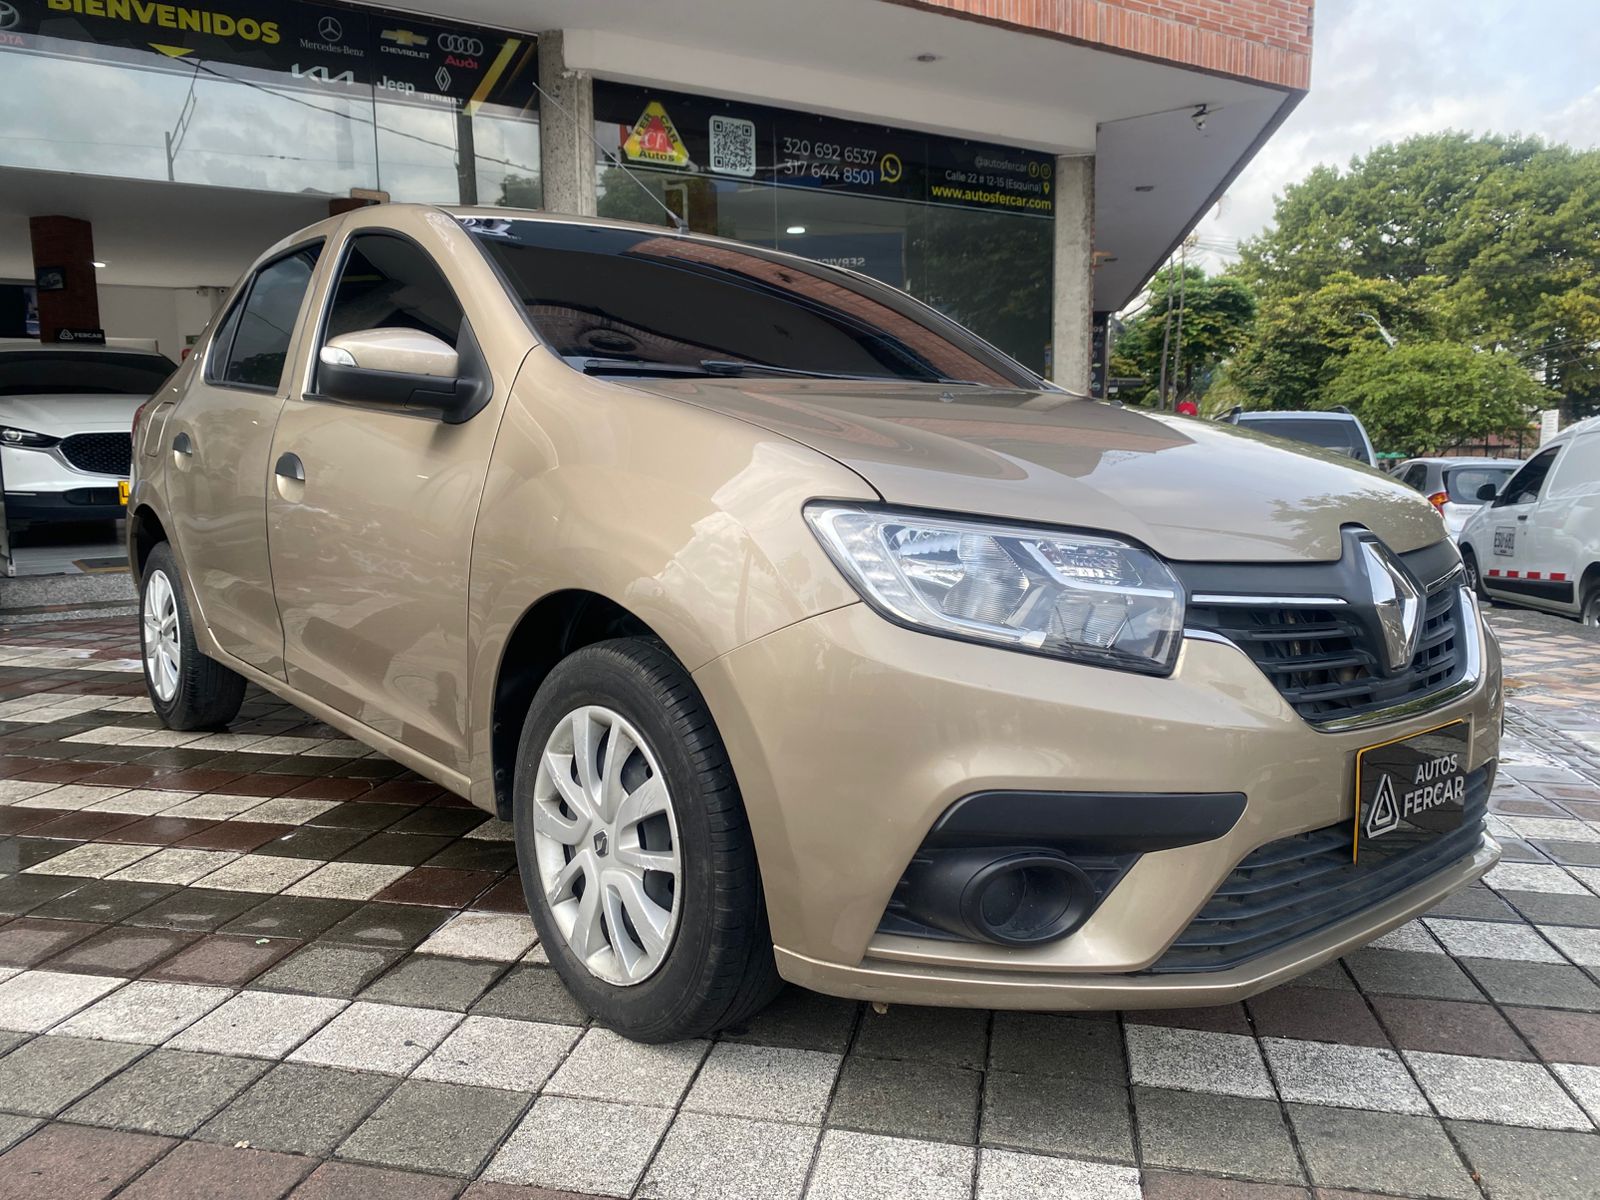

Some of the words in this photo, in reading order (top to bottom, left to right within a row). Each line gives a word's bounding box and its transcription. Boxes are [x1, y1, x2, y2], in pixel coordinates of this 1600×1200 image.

[47, 0, 281, 44] BIENVENIDOS
[0, 33, 25, 46] OTA
[300, 39, 365, 57] Mercedes-Benz
[380, 45, 431, 60] CHEVROLET
[444, 55, 479, 70] Audi
[376, 75, 415, 96] Jeep
[639, 150, 675, 162] Autos
[783, 137, 811, 156] 320
[814, 142, 841, 161] 692
[844, 147, 877, 165] 6537
[784, 158, 807, 177] 317
[811, 162, 840, 181] 644
[843, 167, 874, 185] 8501
[945, 170, 967, 182] Calle
[967, 173, 978, 184] 22
[1005, 179, 1041, 194] (Esquina)
[931, 185, 1052, 210] www.autosfercar.com
[1414, 753, 1458, 784] AUTOS
[1403, 776, 1465, 817] FERCAR
